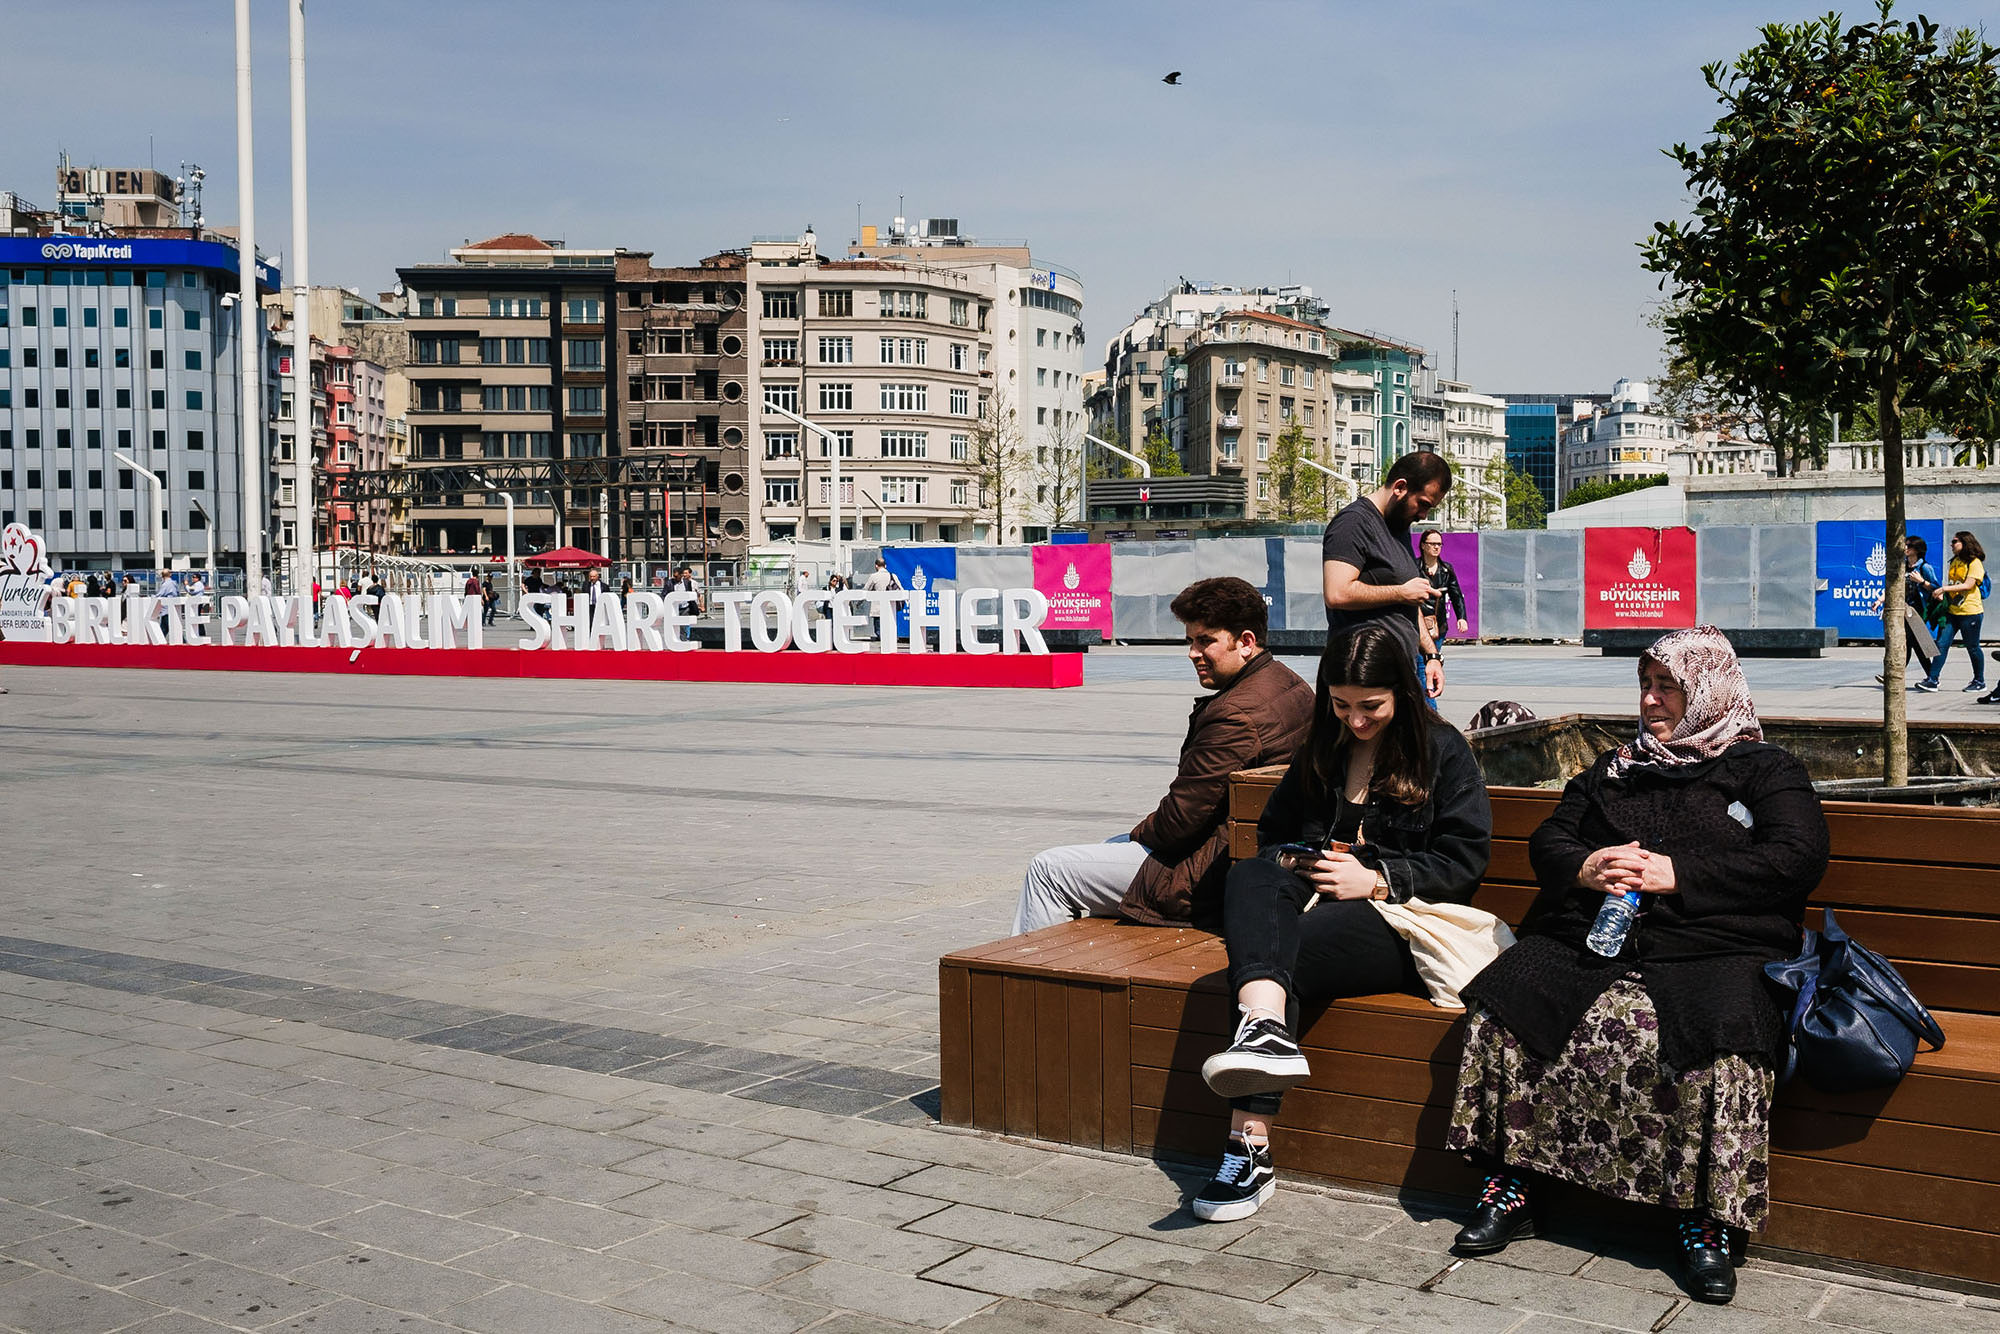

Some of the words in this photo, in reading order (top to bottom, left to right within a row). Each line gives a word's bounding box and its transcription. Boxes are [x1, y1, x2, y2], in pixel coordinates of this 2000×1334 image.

[73, 244, 132, 260] YapıKredi
[1, 574, 44, 617] Turkey
[1599, 587, 1681, 605] BÜYÜKŞEHİR
[1833, 585, 1885, 600] BÜYÜK
[31, 620, 45, 630] 2024
[221, 594, 483, 663] PAYLAŞALIM
[519, 591, 702, 652] SHARE
[712, 587, 1050, 656] TOGETHER
